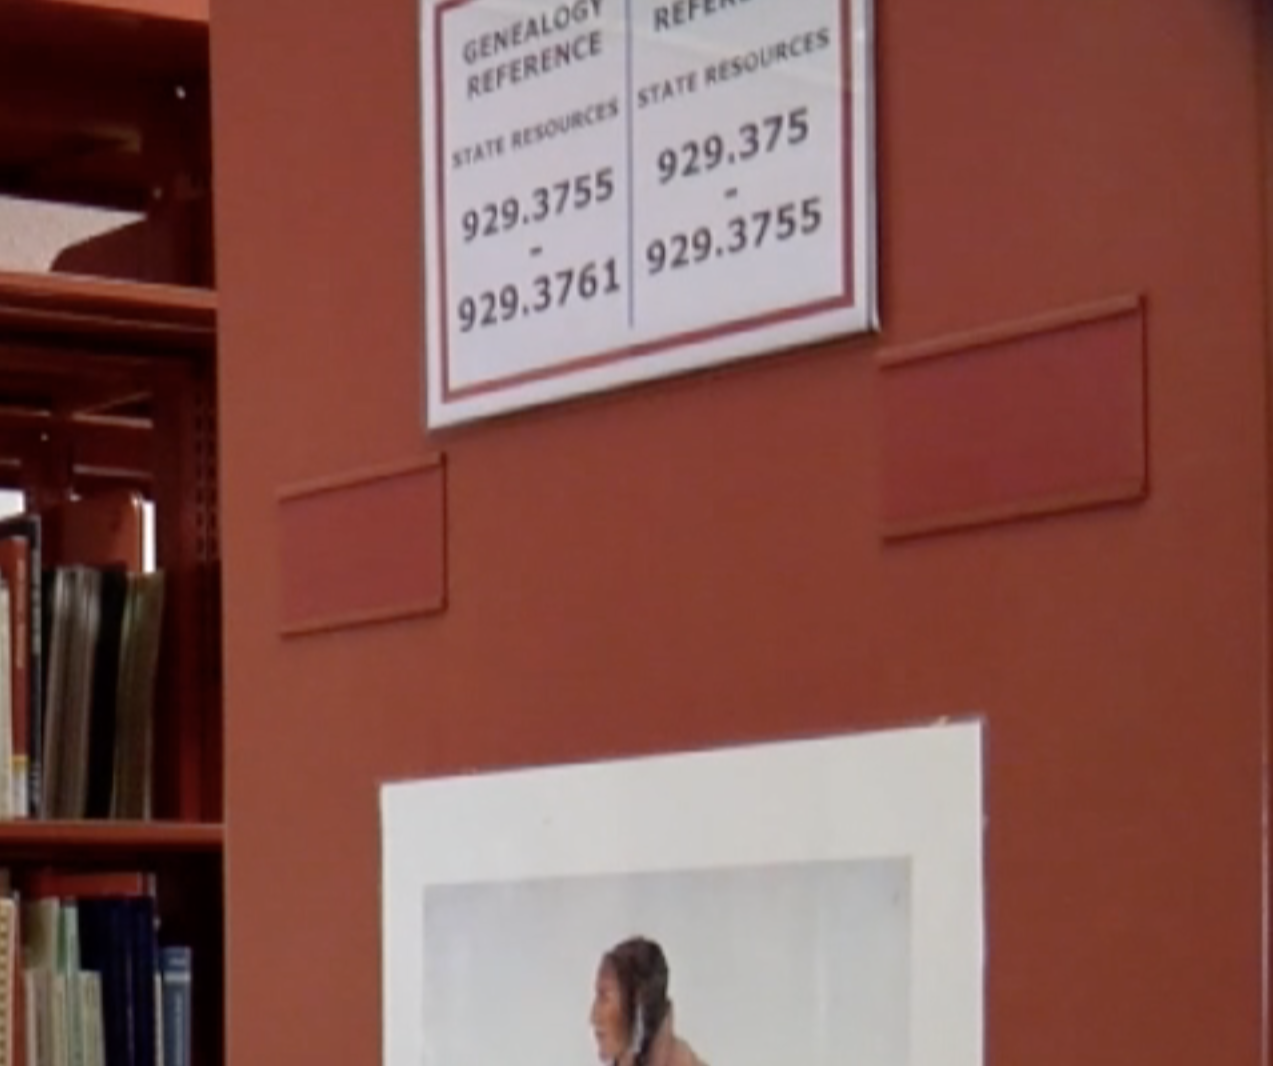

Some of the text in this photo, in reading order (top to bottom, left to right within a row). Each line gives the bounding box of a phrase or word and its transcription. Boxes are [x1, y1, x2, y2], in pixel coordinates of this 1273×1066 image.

[463, 0, 601, 65] GENEALOGY
[467, 30, 602, 100] REFERENCE
[638, 27, 830, 109] STATE RESOURCES
[452, 97, 618, 168] STATE RESOURCES
[658, 106, 809, 185] 929.375
[462, 166, 614, 243] 929.3755
[646, 196, 821, 275] 929.3755
[458, 256, 620, 333] 929.3761
